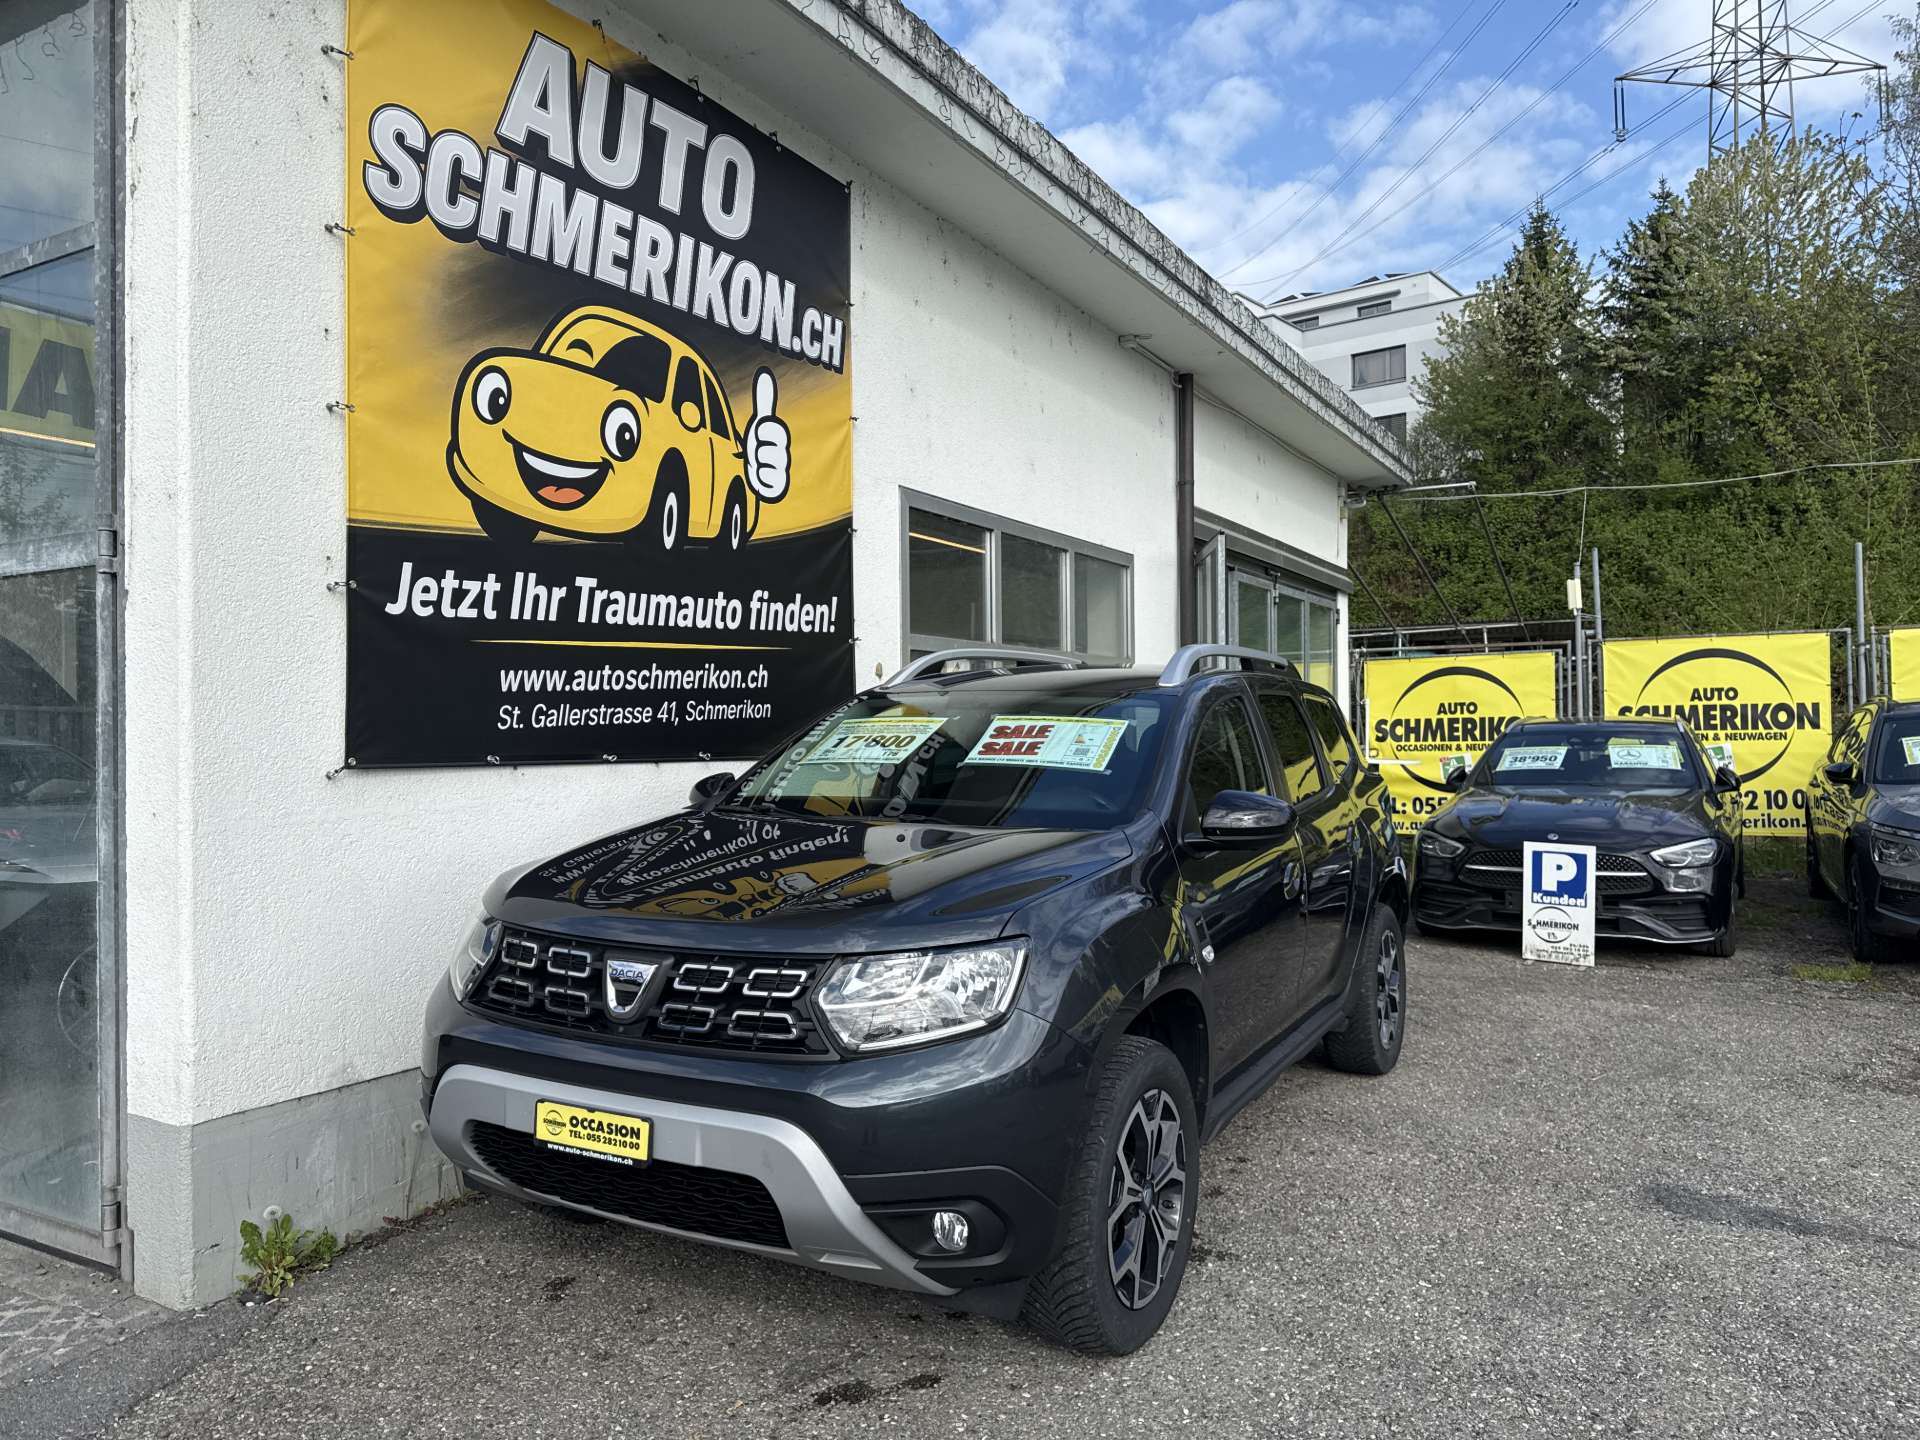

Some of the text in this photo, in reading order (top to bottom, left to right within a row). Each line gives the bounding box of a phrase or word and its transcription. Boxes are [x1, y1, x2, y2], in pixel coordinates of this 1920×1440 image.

[499, 33, 756, 241] AUTO
[365, 106, 844, 370] SCHMERIKON.CH
[384, 561, 837, 632] Jetzt Ihr Traumauto finden!
[500, 662, 768, 692] www.autoschmerikon.ch
[1690, 686, 1738, 701] AUTO
[498, 700, 771, 729] St. Gallerstrasse 41, Schmerikon
[1437, 701, 1478, 715] AUTO
[989, 724, 1056, 740] SALE
[1712, 732, 1721, 741] &
[1725, 731, 1788, 741] NEUWAGEN
[831, 734, 917, 749] 17'800
[977, 740, 1045, 756] SALE
[1396, 743, 1452, 752] OCCASIONEN
[1456, 743, 1462, 752] &
[1509, 755, 1558, 763] 38'950
[1763, 789, 1788, 810] 10
[1541, 852, 1578, 892] P
[1532, 892, 1586, 907] Kunden
[1527, 919, 1580, 931] SHMERIKON
[609, 968, 645, 979] DACIA
[568, 1115, 641, 1141] OCCASION
[568, 1129, 586, 1141] TEL:
[547, 1142, 634, 1166] www.auto-schmerikon.ch
